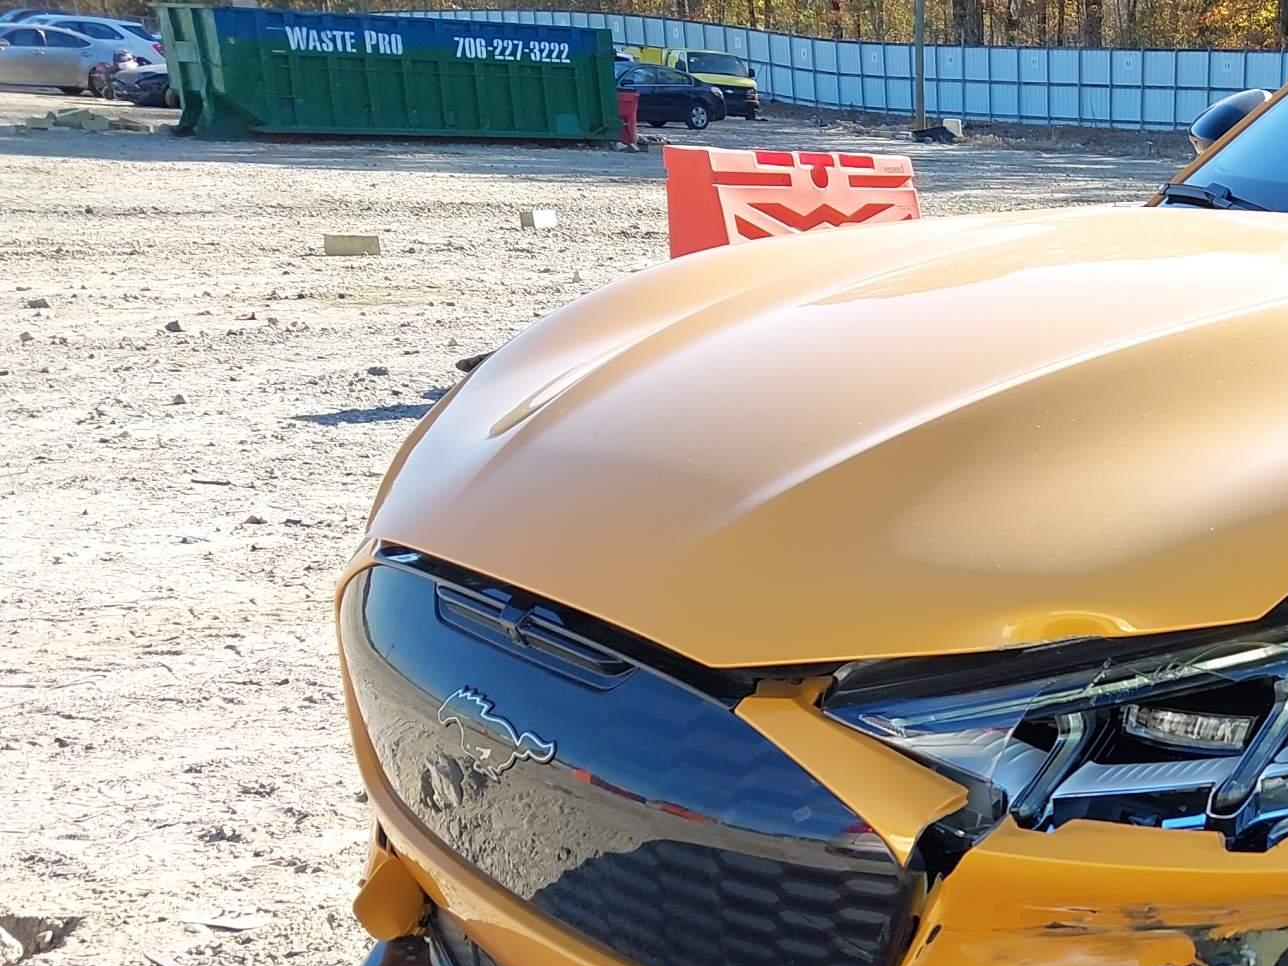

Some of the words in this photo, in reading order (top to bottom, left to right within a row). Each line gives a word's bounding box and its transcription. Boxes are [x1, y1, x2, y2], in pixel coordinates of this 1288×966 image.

[284, 25, 357, 53] WASTE
[364, 30, 403, 55] PRO
[453, 36, 570, 63] 706-227-3222
